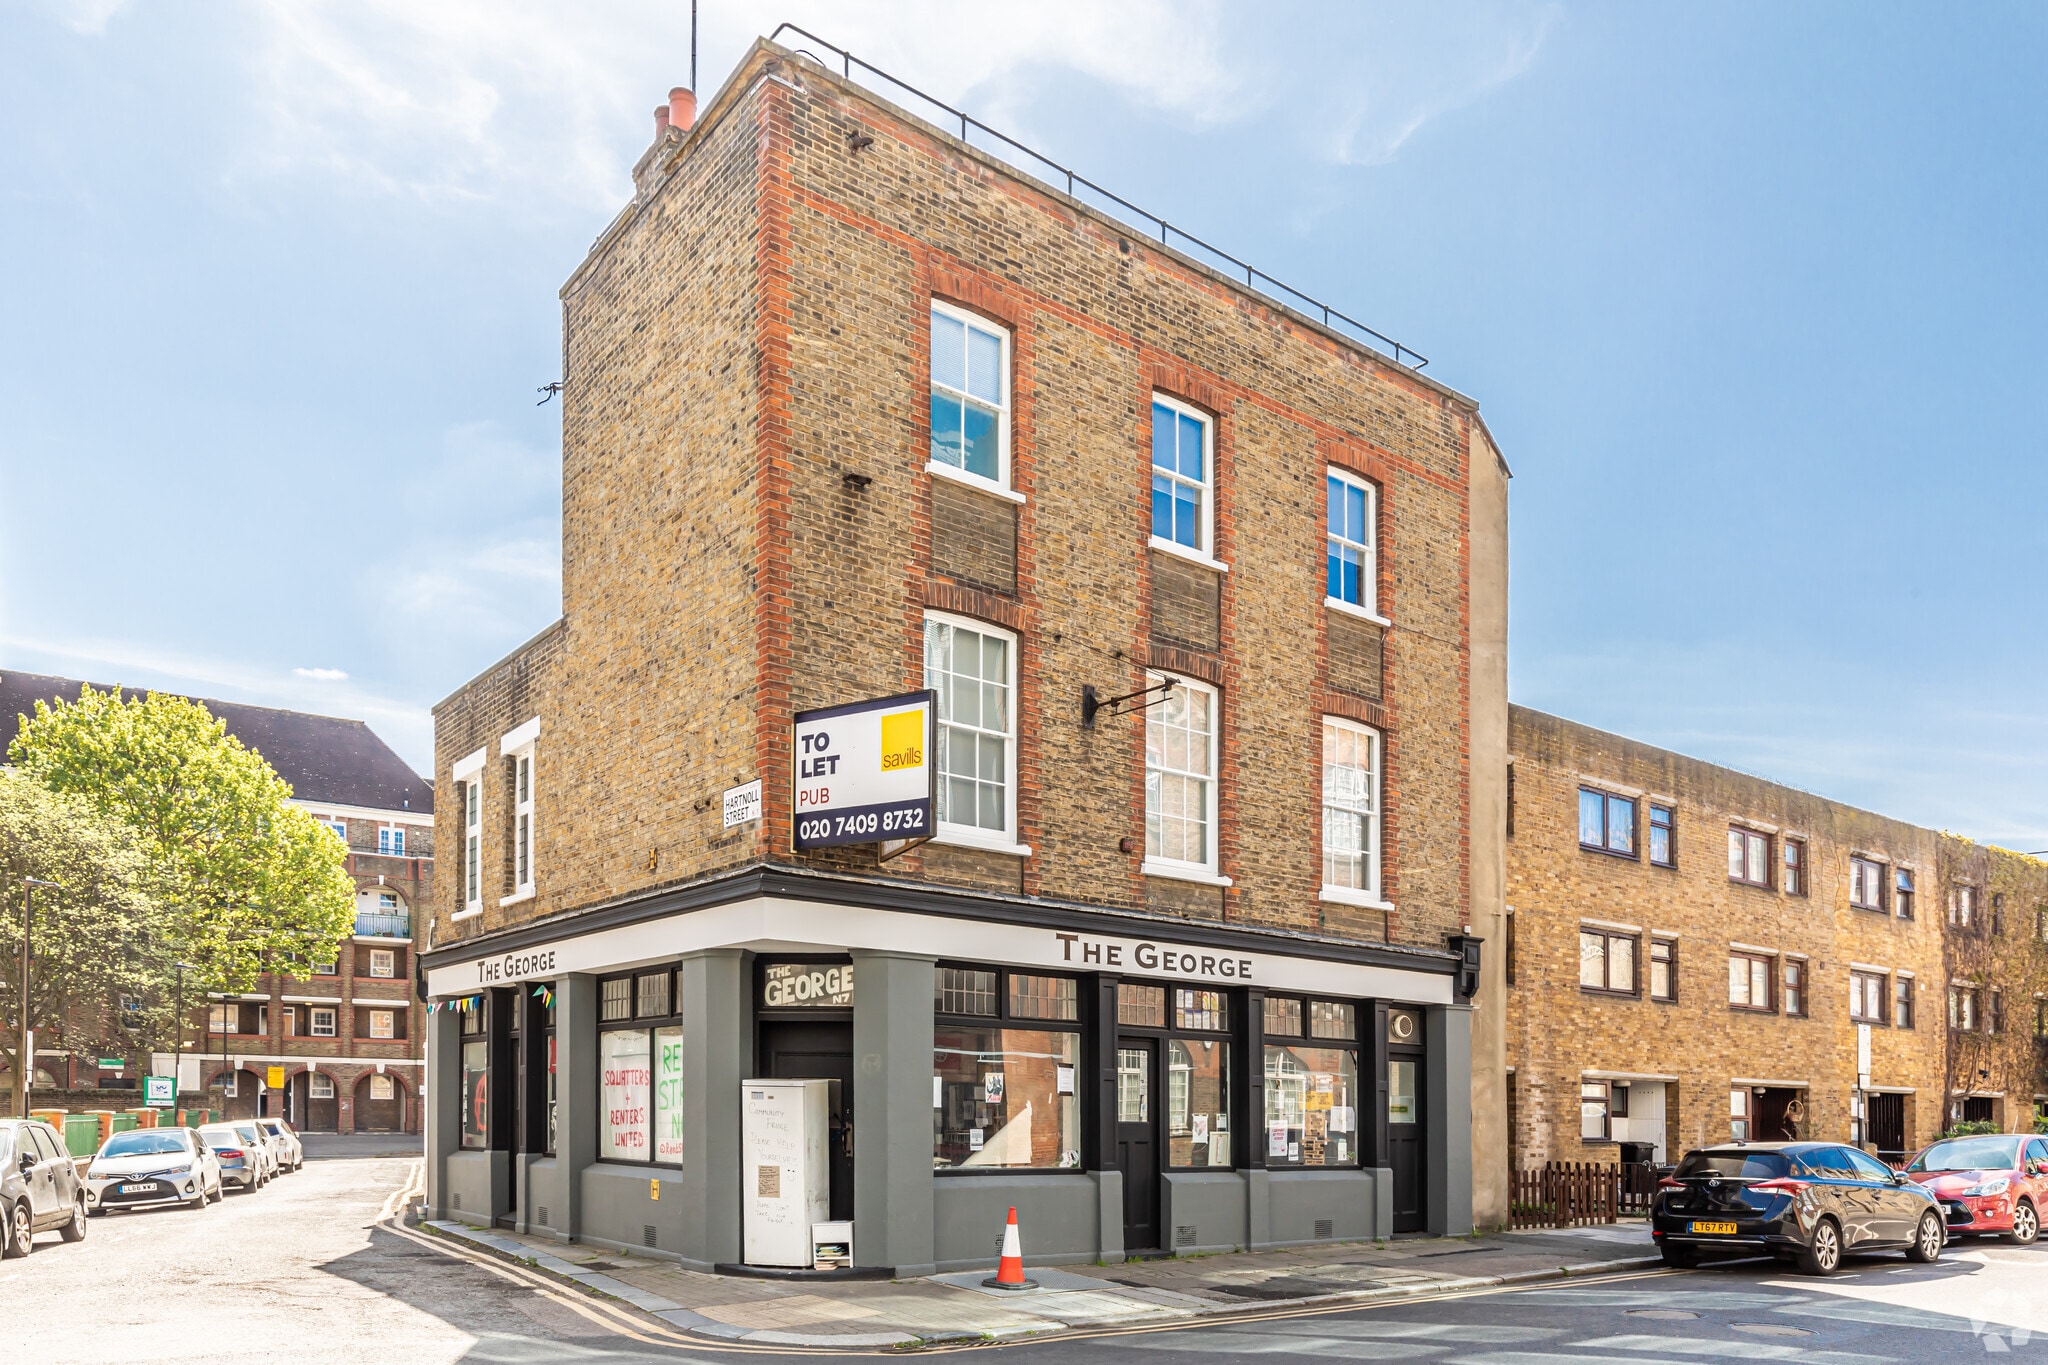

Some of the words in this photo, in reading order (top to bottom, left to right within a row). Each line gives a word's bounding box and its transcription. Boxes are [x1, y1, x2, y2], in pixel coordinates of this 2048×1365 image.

[801, 732, 830, 754] TO
[801, 754, 840, 779] LET
[883, 747, 922, 768] savills
[725, 789, 759, 811] HARTNOLL
[800, 787, 830, 807] PUB
[725, 806, 749, 825] STREET
[800, 819, 831, 840] 020
[835, 813, 878, 836] 7409
[882, 808, 923, 831] 8732
[1056, 932, 1122, 967] THE
[1134, 943, 1252, 979] GEORGE
[477, 960, 500, 982] THE
[504, 951, 555, 977] GEORGE
[767, 965, 791, 979] THE
[765, 965, 854, 1006] GEORGE
[832, 993, 850, 1004] N7
[605, 1069, 650, 1087] SQUATTERS
[610, 1107, 644, 1126] RENTERS
[672, 1113, 683, 1139] N
[615, 1131, 644, 1148] UNITED
[1694, 1223, 1716, 1231] LT67
[1718, 1223, 1736, 1232] RTV
